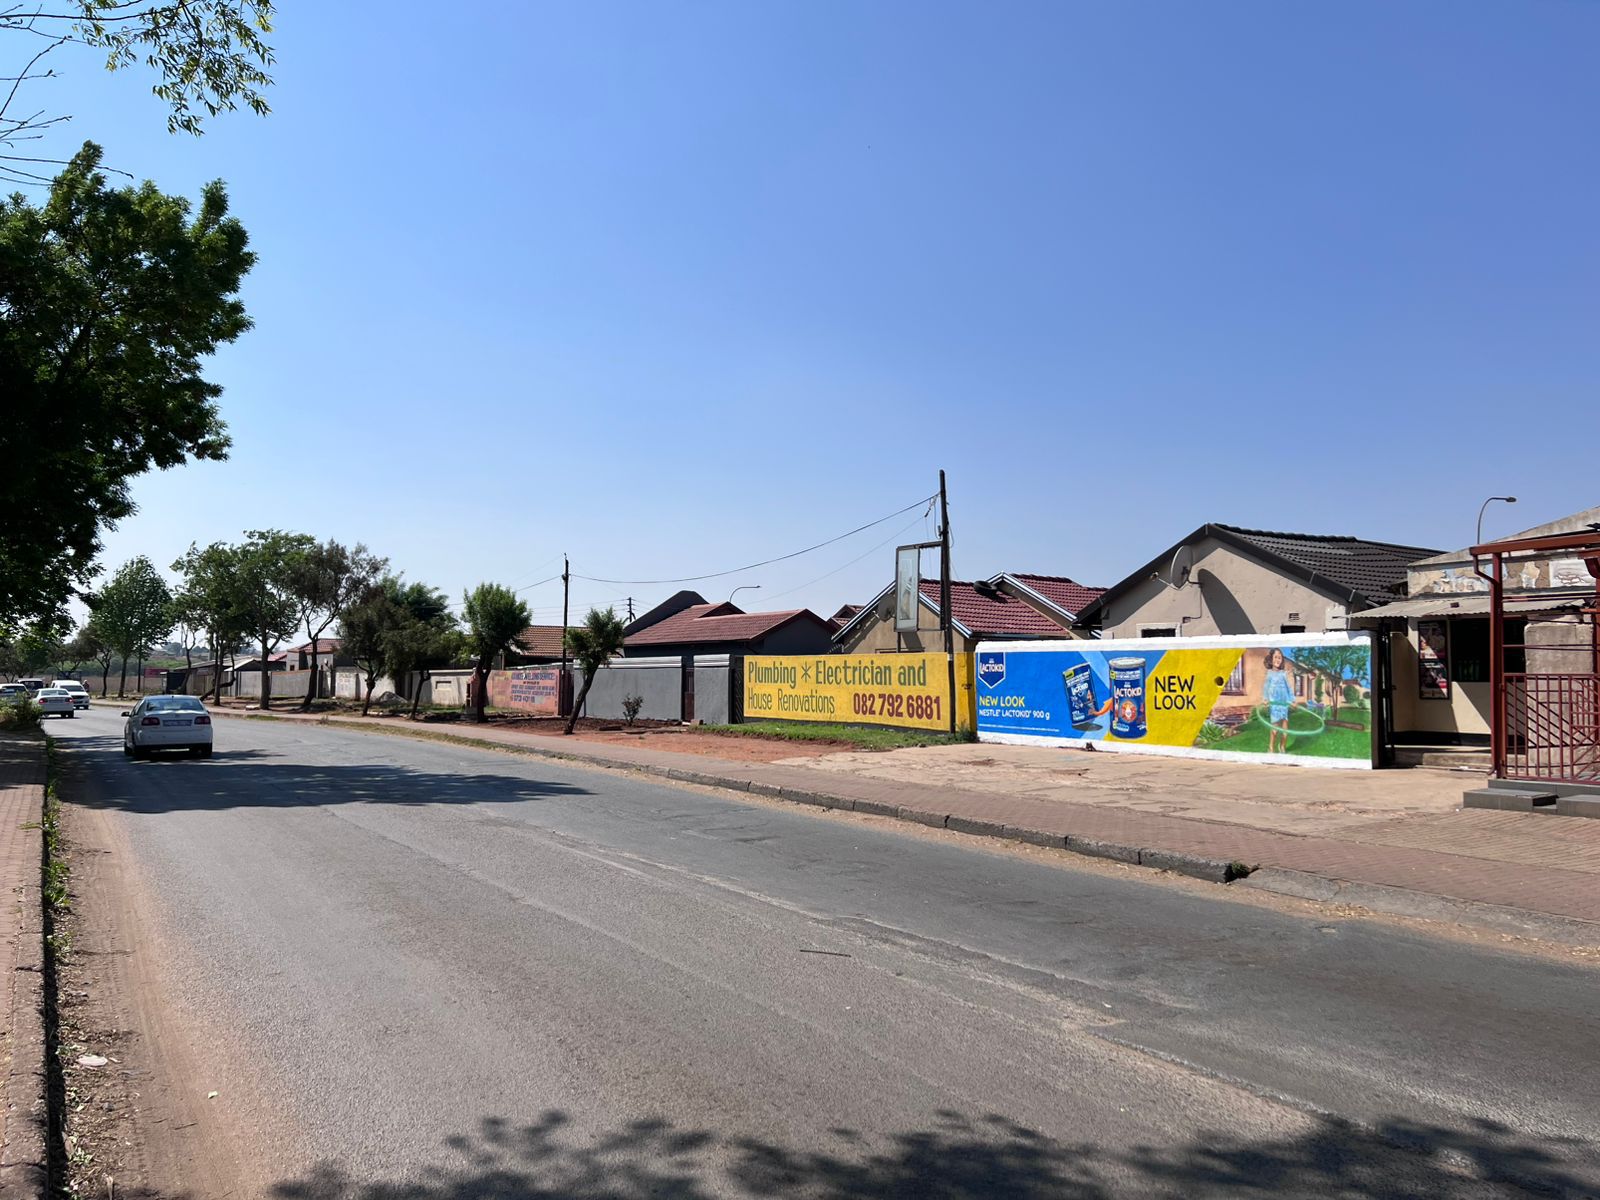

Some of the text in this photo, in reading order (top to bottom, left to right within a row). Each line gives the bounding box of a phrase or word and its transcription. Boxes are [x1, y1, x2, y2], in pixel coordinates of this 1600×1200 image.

[748, 659, 927, 689] Plumbing Electrician and
[980, 662, 1004, 674] LACTOKID
[1114, 685, 1142, 698] LACTOKID
[1154, 674, 1195, 693] NEW
[748, 687, 835, 714] House Renovations
[853, 692, 941, 721] 082 792 6881
[979, 695, 1025, 708] NEW LOOK
[1154, 694, 1197, 710] LOOK
[1033, 710, 1044, 719] 900
[1045, 711, 1051, 721] g
